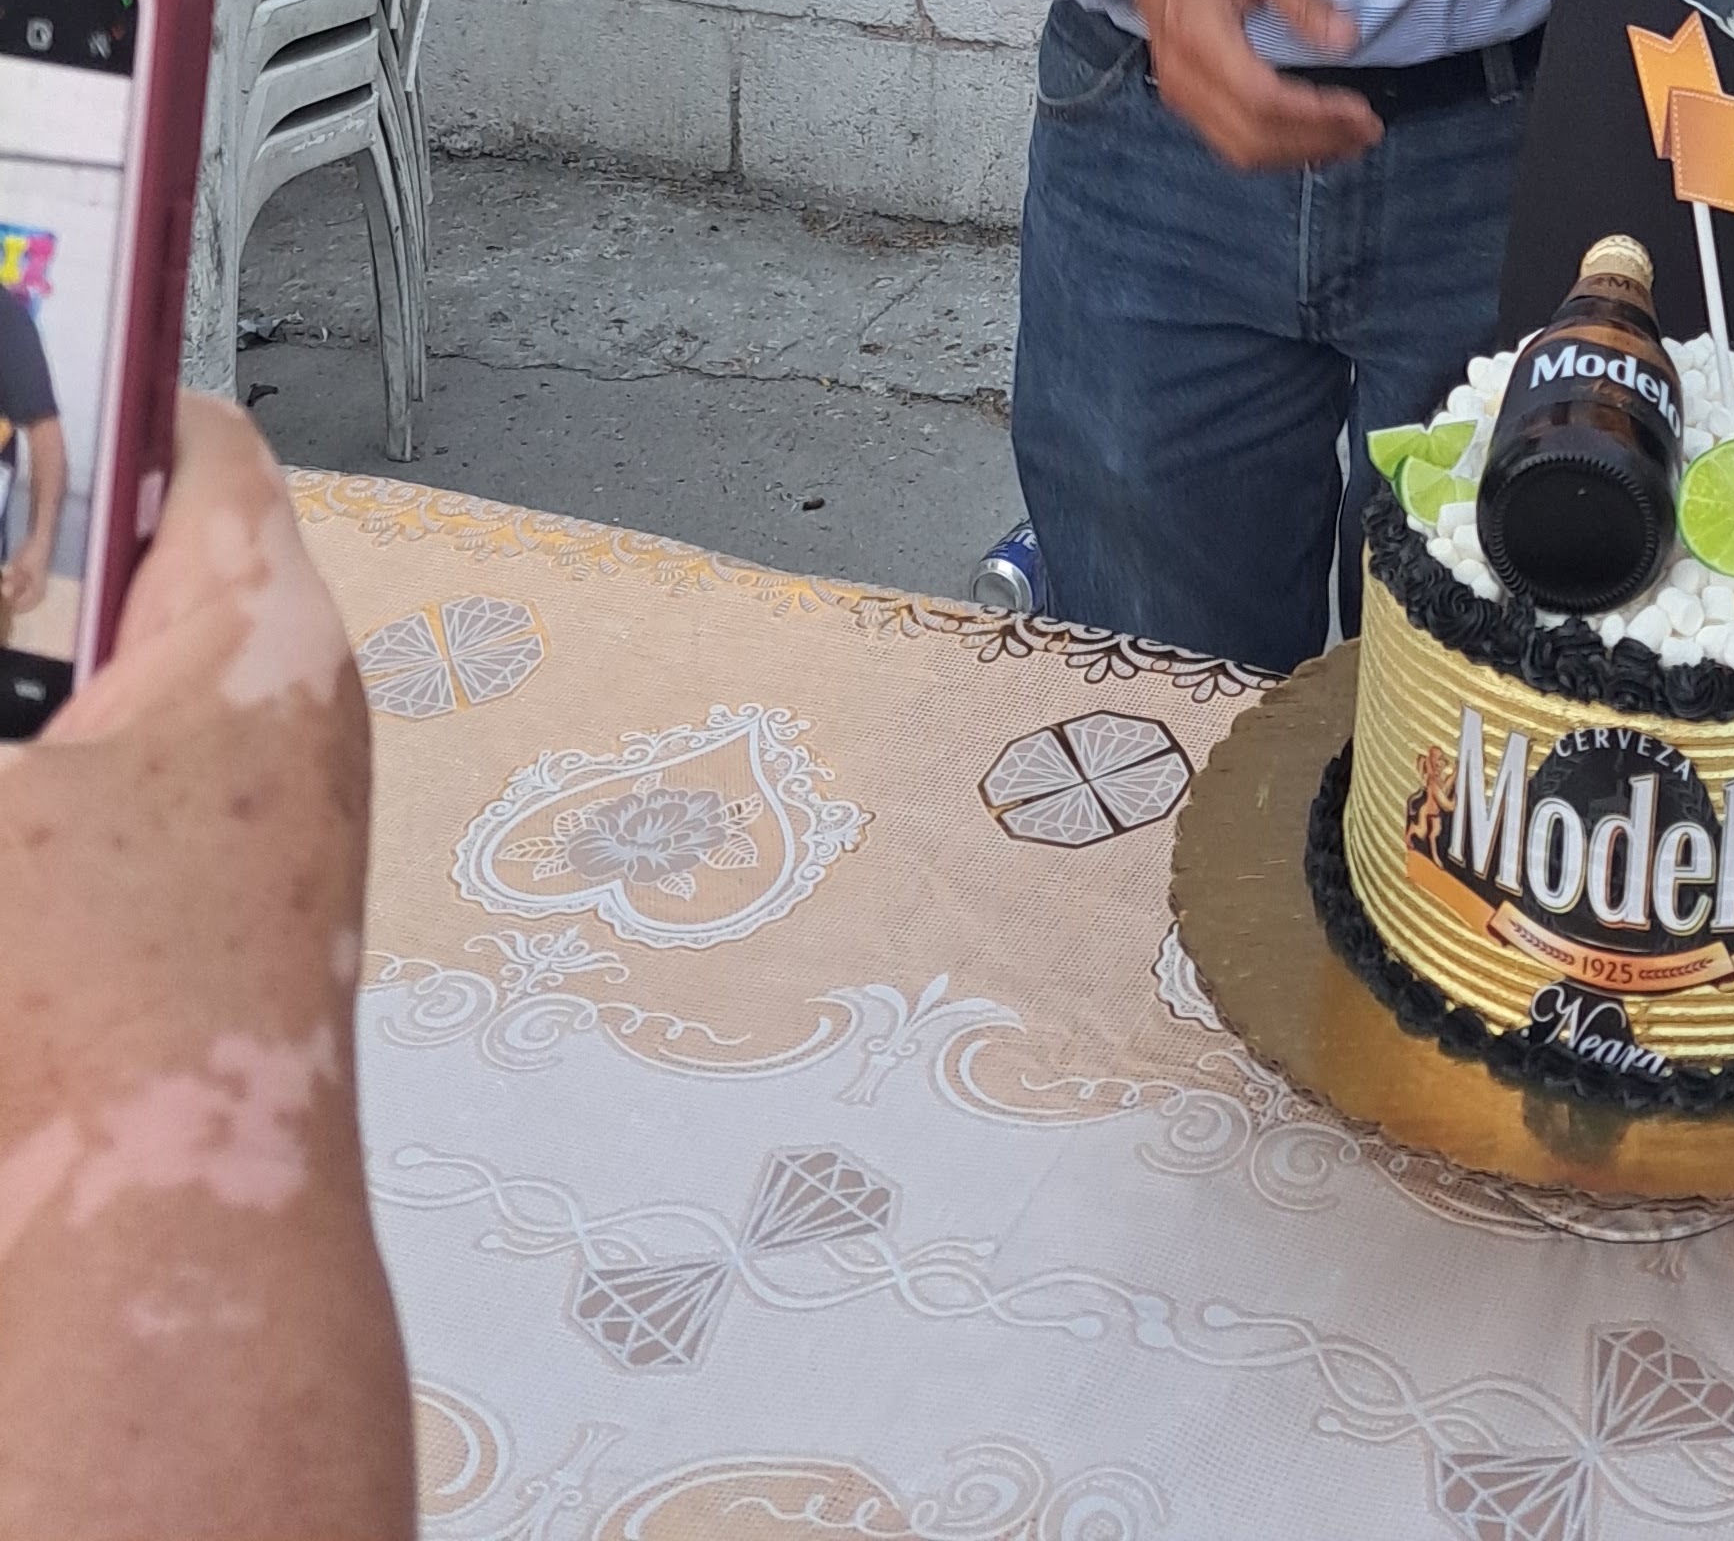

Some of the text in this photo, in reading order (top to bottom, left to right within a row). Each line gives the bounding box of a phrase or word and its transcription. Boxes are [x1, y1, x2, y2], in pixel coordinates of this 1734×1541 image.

[1528, 344, 1681, 439] Modelo
[1555, 727, 1693, 783] CERVEZA
[1582, 954, 1634, 985] 1925
